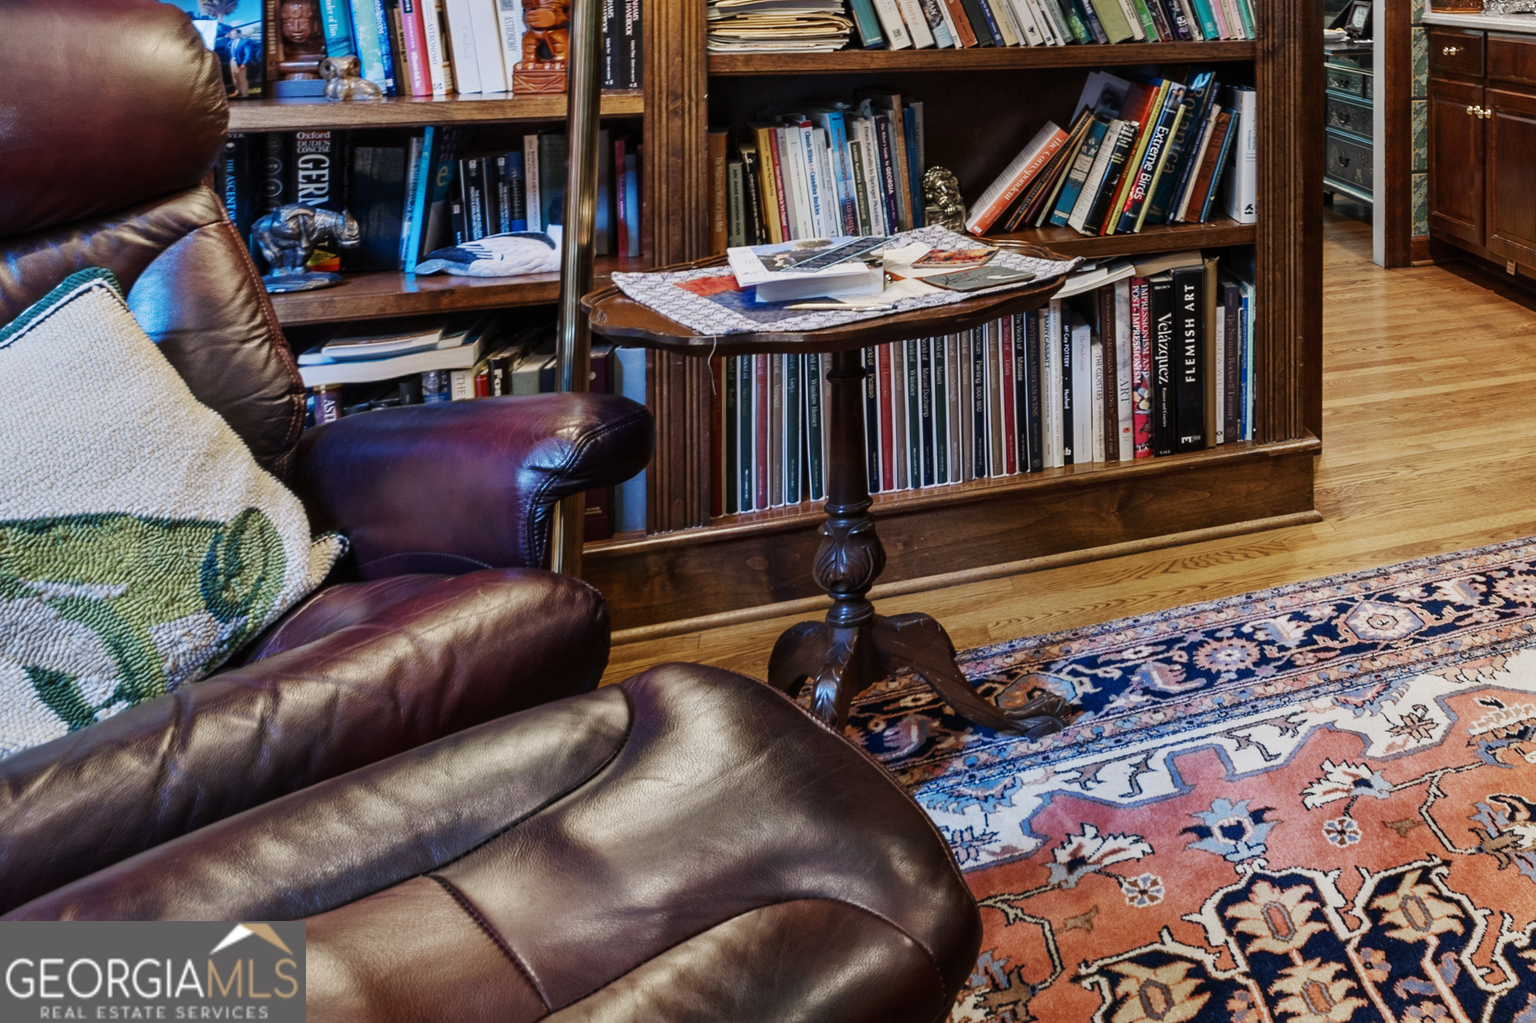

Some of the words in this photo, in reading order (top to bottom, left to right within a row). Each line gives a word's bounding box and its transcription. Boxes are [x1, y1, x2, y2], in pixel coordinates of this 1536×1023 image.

[428, 22, 440, 66] ASTRONOMY
[504, 16, 519, 51] ASTRONOMY
[296, 131, 331, 139] Oxford
[804, 131, 812, 148] Classic
[1049, 137, 1064, 150] The
[1144, 125, 1168, 172] Extreme
[226, 159, 234, 172] THE
[865, 142, 873, 167] Katahdin
[809, 171, 818, 195] Canadian
[867, 175, 877, 199] Springer
[884, 166, 894, 195] GEORGIA
[1004, 151, 1050, 201] Correspondent
[1133, 173, 1152, 200] Birds
[226, 174, 236, 209] ASCENT
[812, 196, 820, 216] Rockies
[872, 200, 880, 226] Mountain
[1184, 284, 1195, 311] ART
[1131, 285, 1142, 383] POST-IMPRESSIONISM
[1141, 284, 1150, 355] IMPRESSIONISM
[1226, 312, 1235, 327] The
[1106, 337, 1114, 373] AMERICAN
[1157, 312, 1173, 385] Velázquez
[1184, 318, 1196, 383] FLEMISH
[1227, 328, 1235, 357] Norman
[455, 371, 468, 400] THE
[1030, 360, 1038, 394] AMERICAN
[1227, 357, 1235, 390] Rockwell
[1120, 378, 1130, 404] ART
[1227, 391, 1235, 421] Treasury
